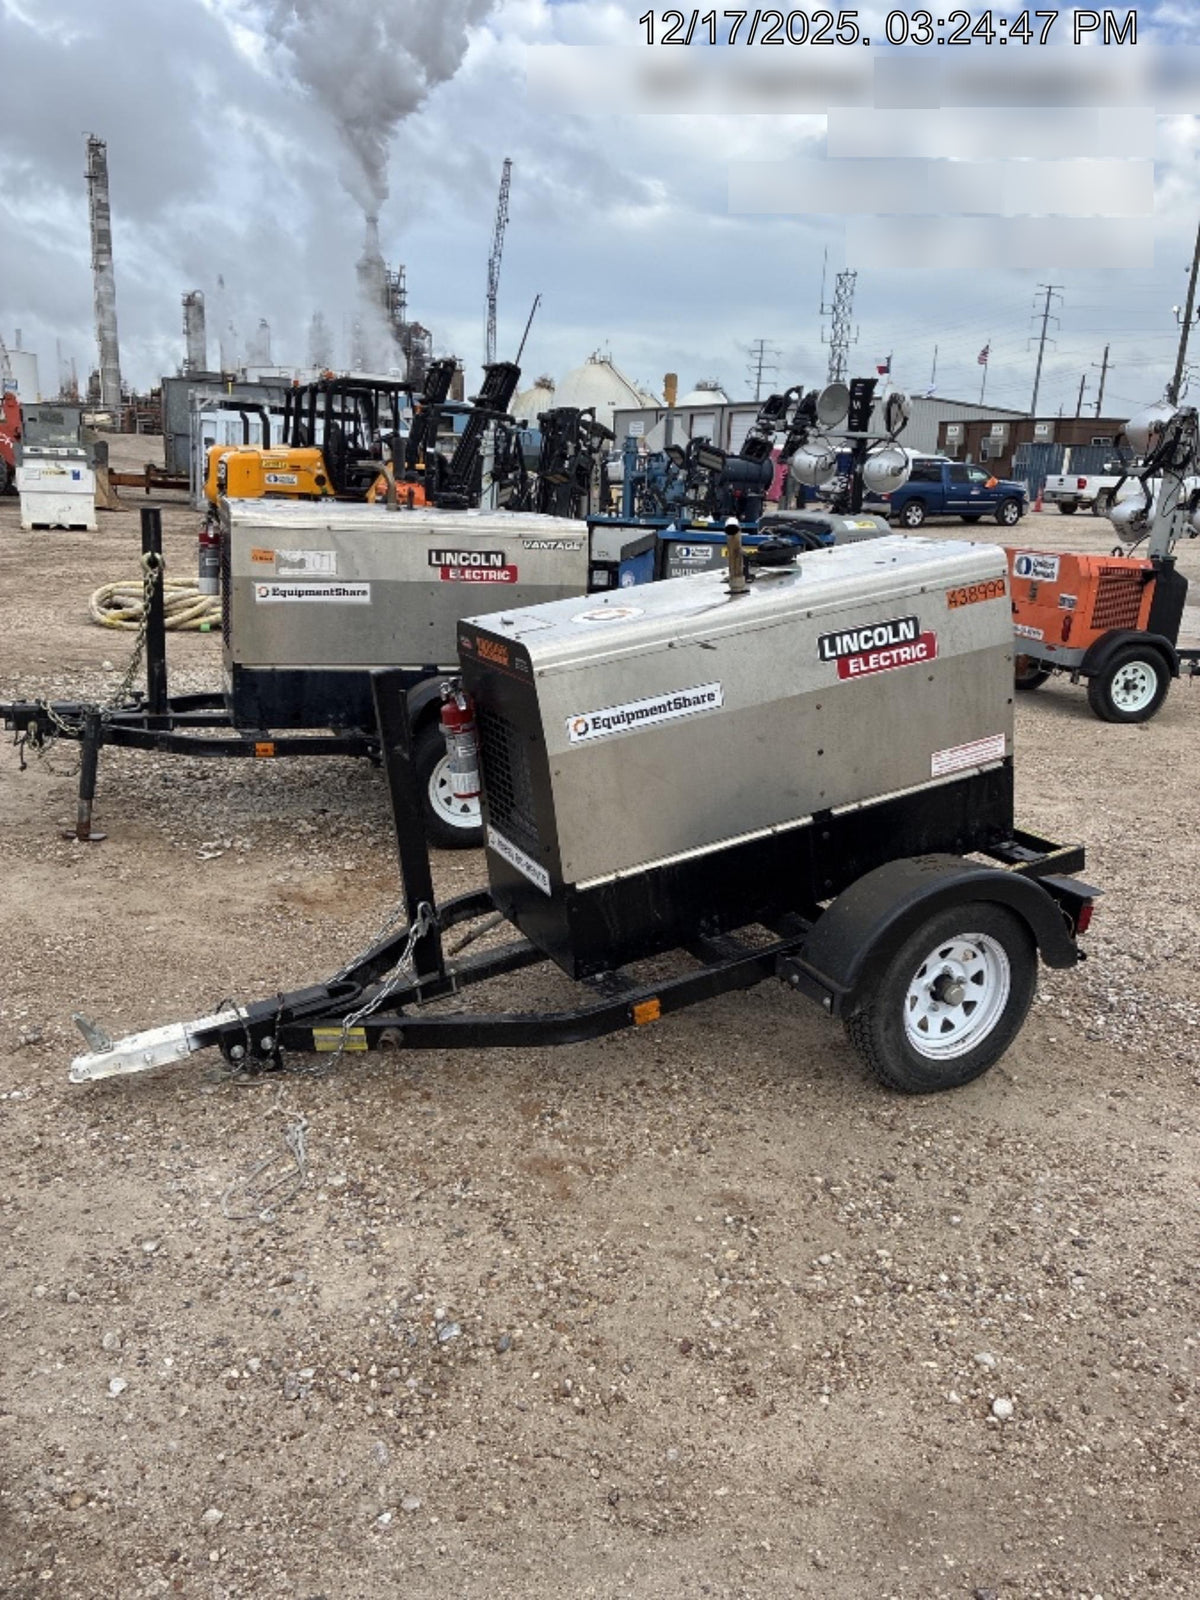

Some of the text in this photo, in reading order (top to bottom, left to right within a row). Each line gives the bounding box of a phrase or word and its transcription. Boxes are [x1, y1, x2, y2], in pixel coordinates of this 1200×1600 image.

[523, 540, 583, 551] VANTAGE
[431, 550, 502, 568] LINCOLN
[449, 569, 511, 581] ELECTRIC
[271, 587, 369, 599] EquipmentShare
[948, 579, 1006, 608] 438999
[823, 619, 916, 658] LINCOLN
[848, 643, 928, 674] ELECTRIC
[591, 690, 717, 731] EquipmentShare
